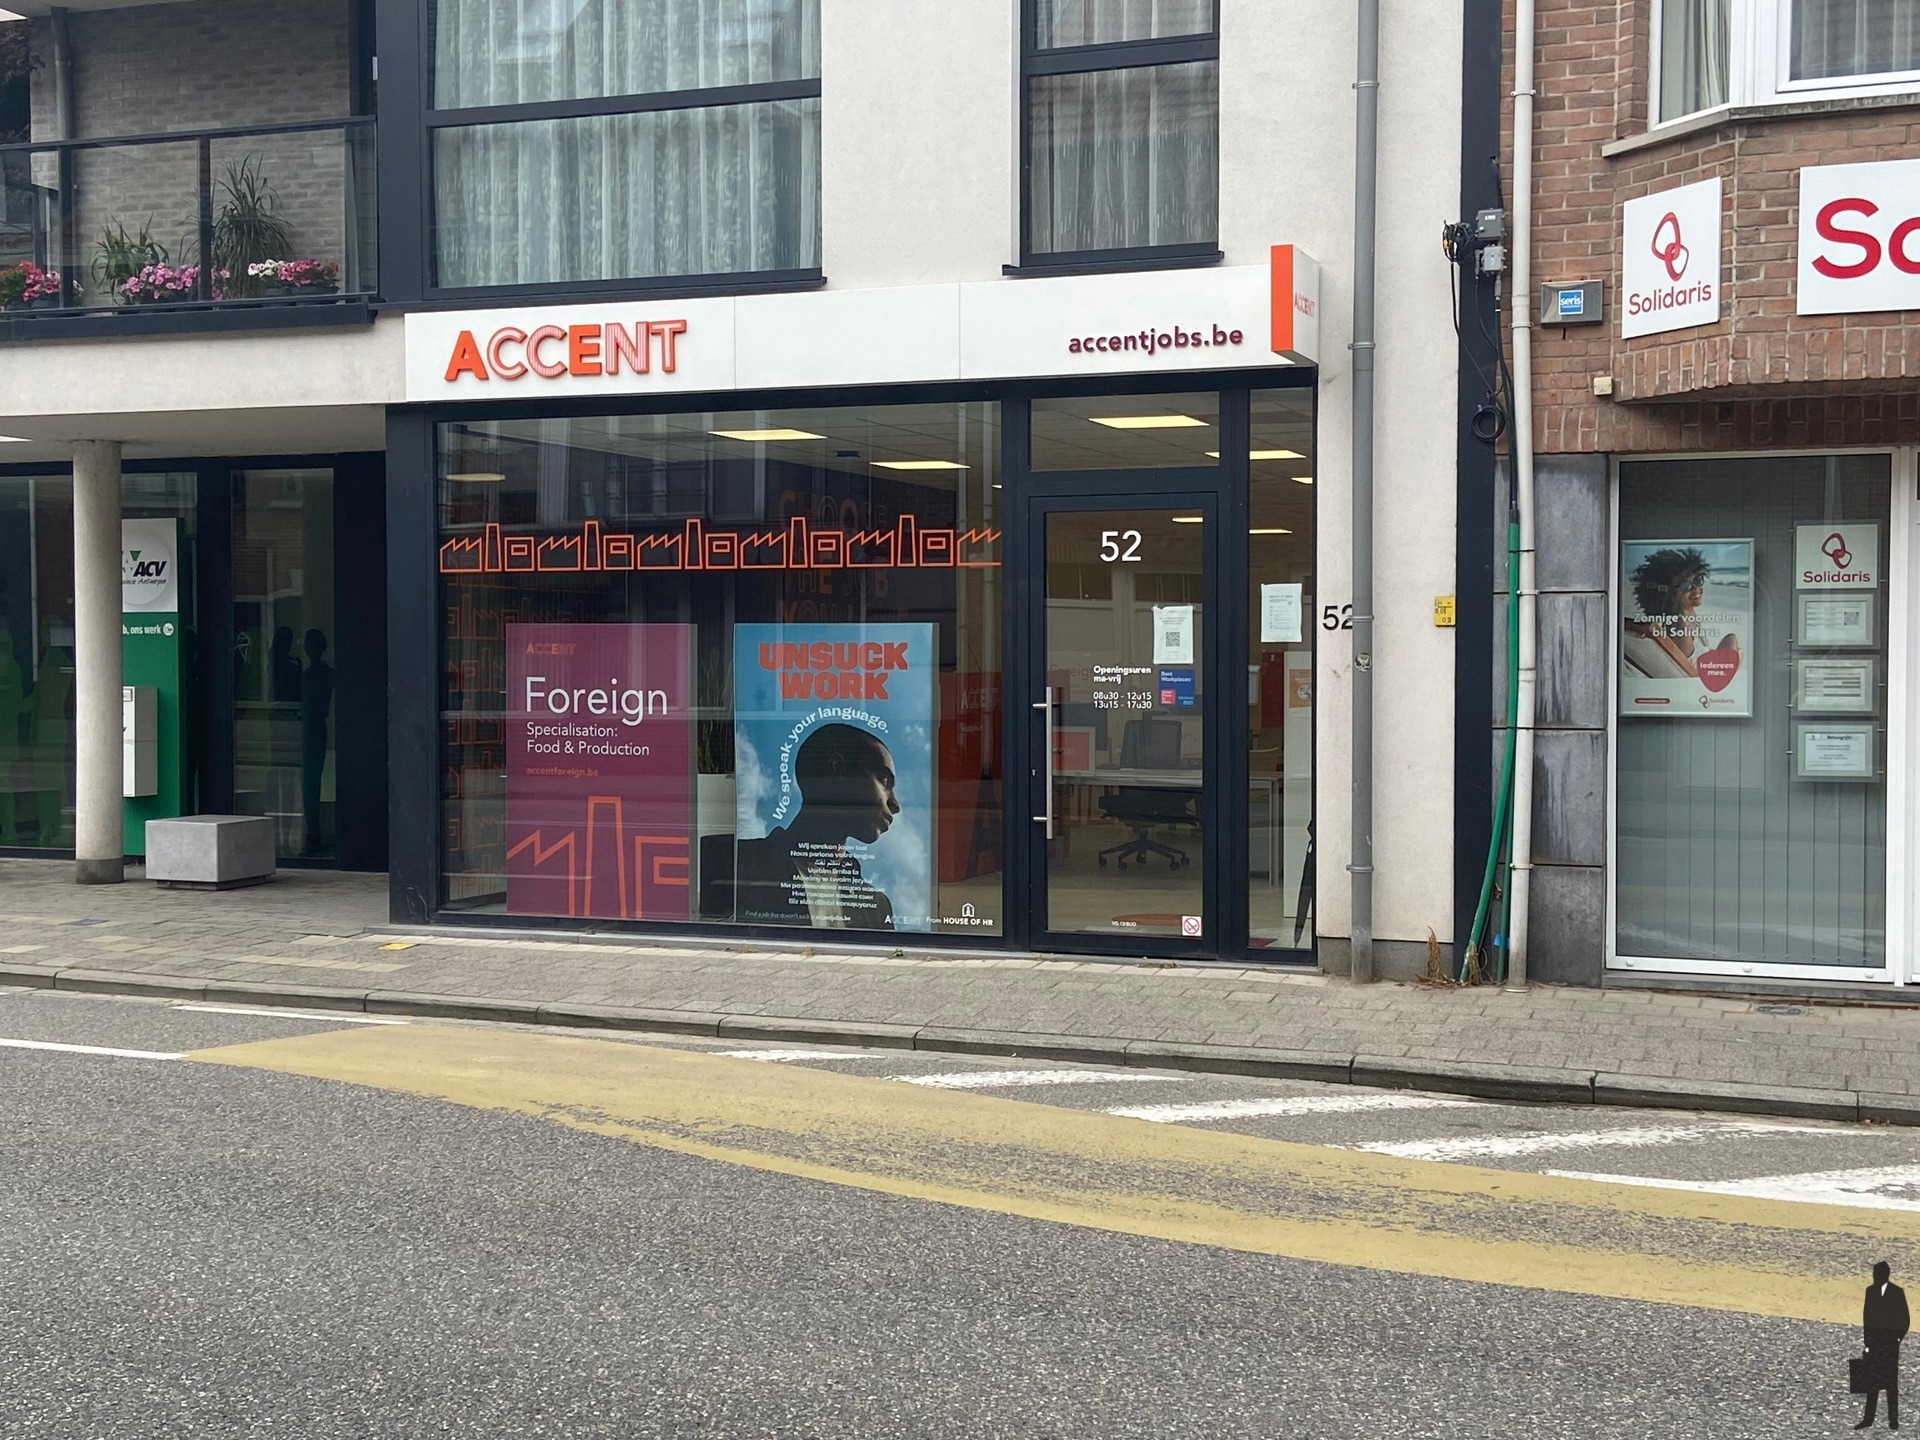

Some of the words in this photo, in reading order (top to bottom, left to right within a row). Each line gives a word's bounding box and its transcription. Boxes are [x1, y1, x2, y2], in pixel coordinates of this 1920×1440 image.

[1294, 291, 1316, 319] ACCENT
[1560, 294, 1582, 306] seris
[1628, 280, 1713, 317] Solidaris
[1068, 323, 1244, 356] accentjobs.be
[444, 319, 687, 382] ACCENT
[1100, 530, 1142, 562] 52
[133, 561, 167, 577] ACV
[1802, 570, 1871, 583] Solidaris
[1322, 604, 1353, 631] 52
[1633, 612, 1679, 625] Zonnige
[1680, 612, 1740, 623] voordelen
[130, 626, 143, 634] ons
[144, 624, 161, 635] werk
[1652, 627, 1667, 639] bij
[1670, 627, 1720, 637] Solidaris
[526, 642, 576, 655] ACCENT
[759, 641, 909, 671] UNSUCK
[1093, 665, 1152, 675] Openingsuren
[1699, 661, 1735, 670] Iedereen
[779, 672, 889, 700] WORK
[1093, 674, 1122, 684] ma-vrij
[526, 676, 668, 726] Foreign
[1093, 691, 1119, 700] 08u30
[1126, 691, 1152, 700] 12u15
[1093, 700, 1119, 709] 13u15
[1126, 700, 1152, 709] 17u30
[788, 712, 816, 743] your
[818, 706, 889, 734] language.
[526, 722, 618, 738] Specialisation:
[527, 739, 560, 754] Food
[564, 741, 574, 754] &
[578, 740, 650, 756] Production
[527, 766, 599, 778] accentforeign.be
[779, 742, 793, 792] speak
[772, 796, 791, 820] We
[926, 916, 942, 924] From
[943, 917, 968, 925] HOUSE
[970, 918, 981, 926] OF
[982, 918, 994, 927] HR
